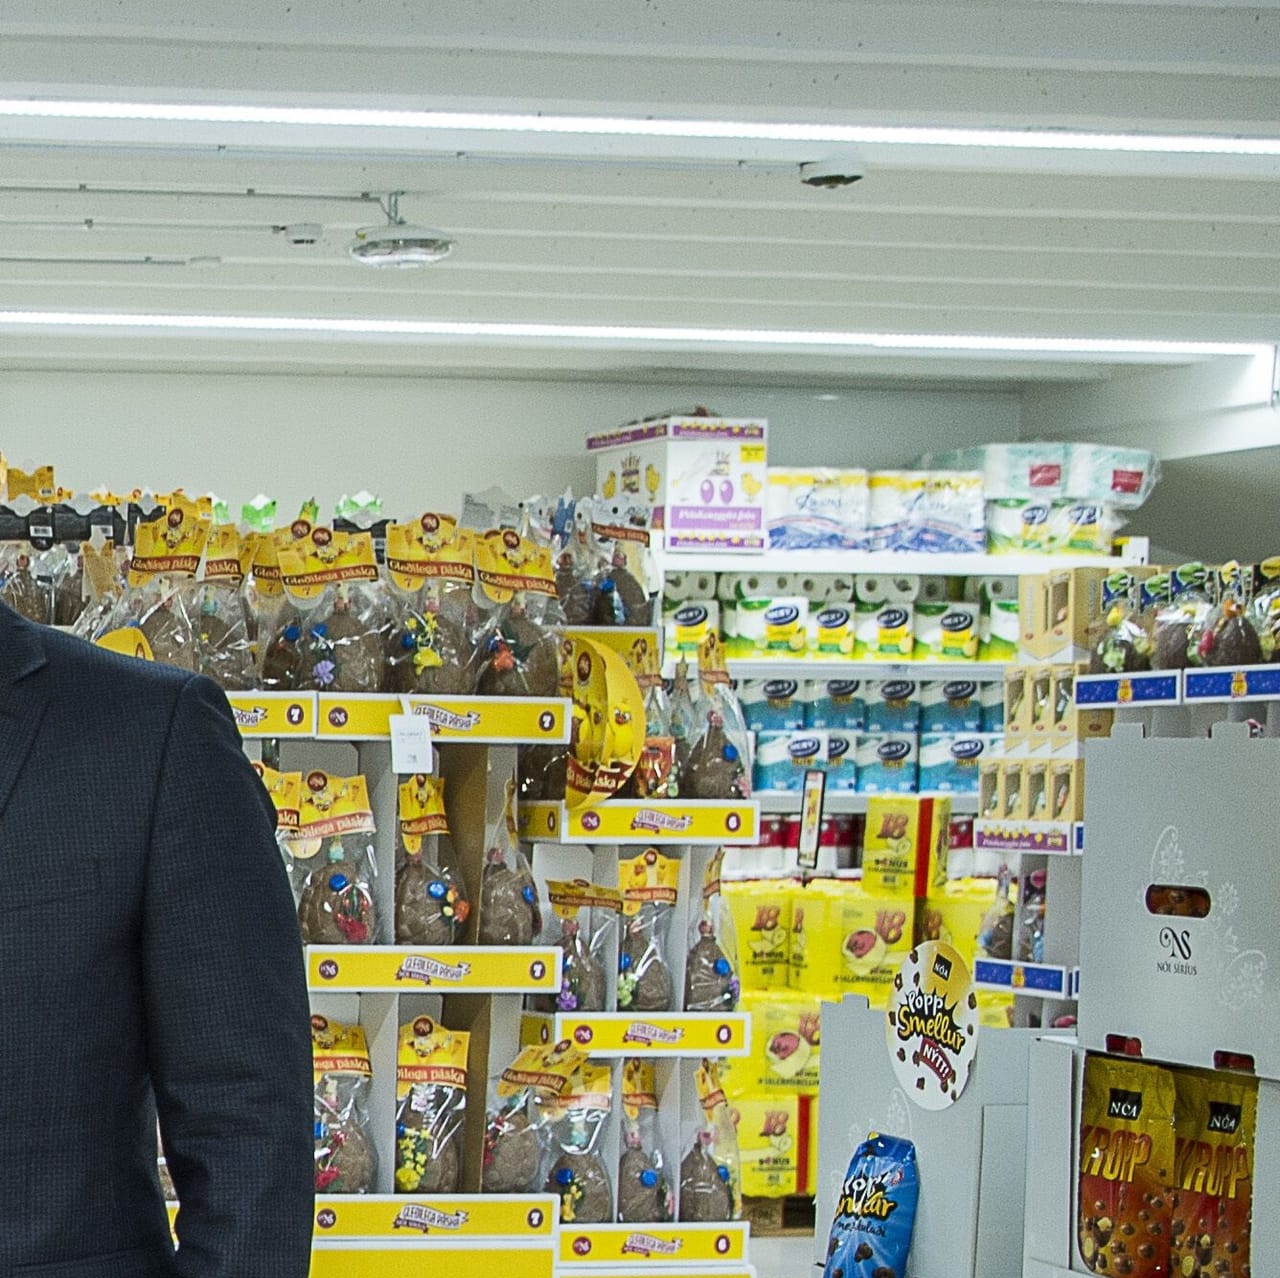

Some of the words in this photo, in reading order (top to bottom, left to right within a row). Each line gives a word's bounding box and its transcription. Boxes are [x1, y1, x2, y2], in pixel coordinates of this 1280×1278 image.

[285, 572, 338, 586] Gleðilega
[340, 567, 376, 581] páska
[389, 560, 438, 576] Gleðilega
[440, 565, 473, 580] páska
[479, 571, 524, 589] Gleðilega
[525, 579, 556, 594] páska
[290, 708, 301, 722] 7
[542, 714, 552, 728] 7
[934, 960, 949, 979] NÓA
[1157, 961, 1173, 973] NÓI
[908, 990, 944, 1016] Popp
[898, 1002, 964, 1051] Smellur
[338, 1058, 371, 1075] páska
[922, 1043, 950, 1077] NÝTT!
[430, 1067, 465, 1086] páska
[1211, 1115, 1236, 1131] NÓA
[530, 1210, 541, 1225] 7
